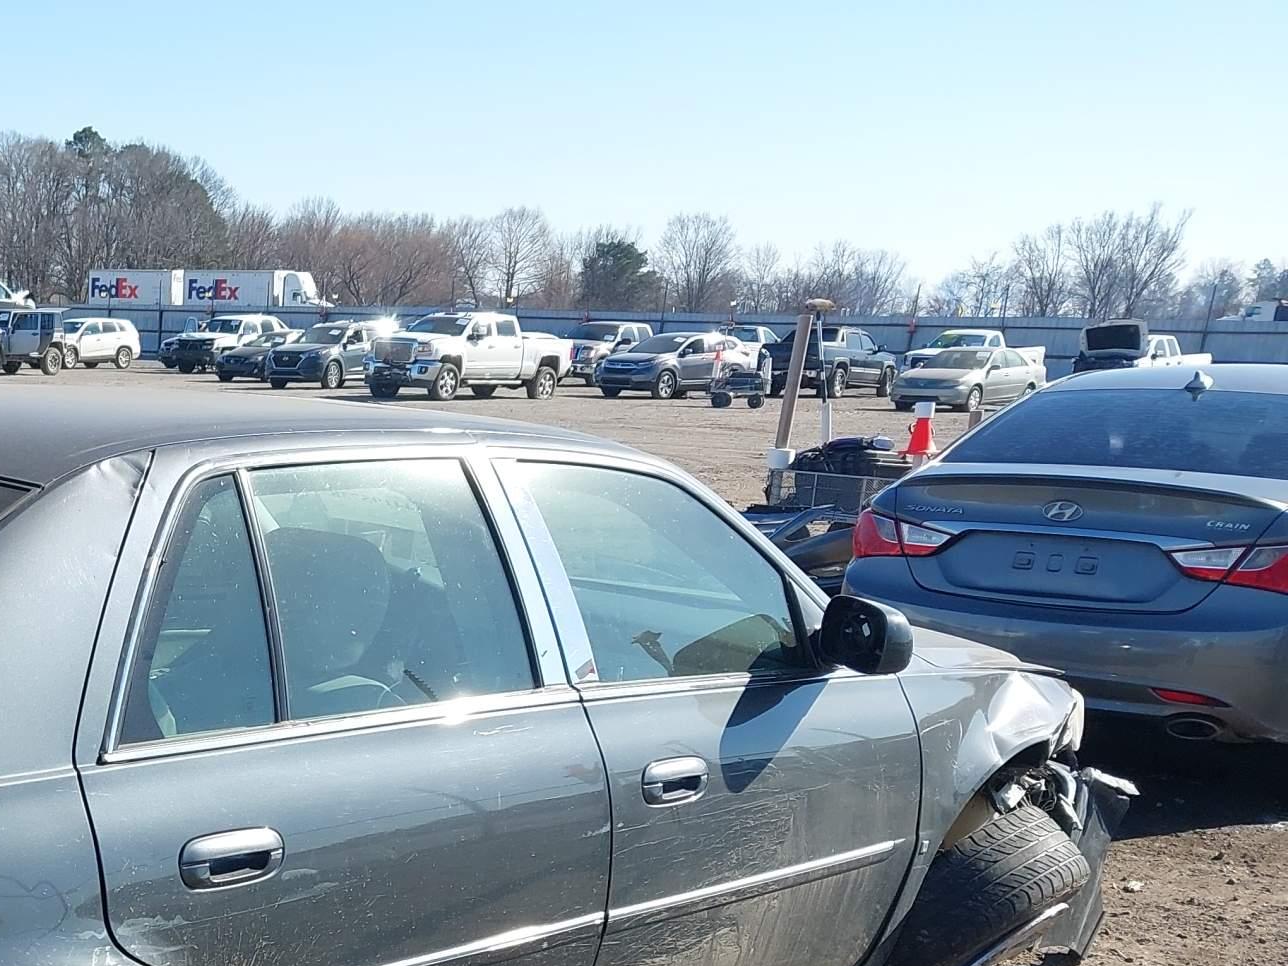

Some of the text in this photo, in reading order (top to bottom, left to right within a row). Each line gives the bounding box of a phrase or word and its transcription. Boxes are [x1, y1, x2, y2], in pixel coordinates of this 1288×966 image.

[91, 278, 139, 299] FedEx
[187, 278, 240, 300] FedEx
[904, 503, 964, 515] SONATA
[1207, 520, 1251, 531] CRAIN
